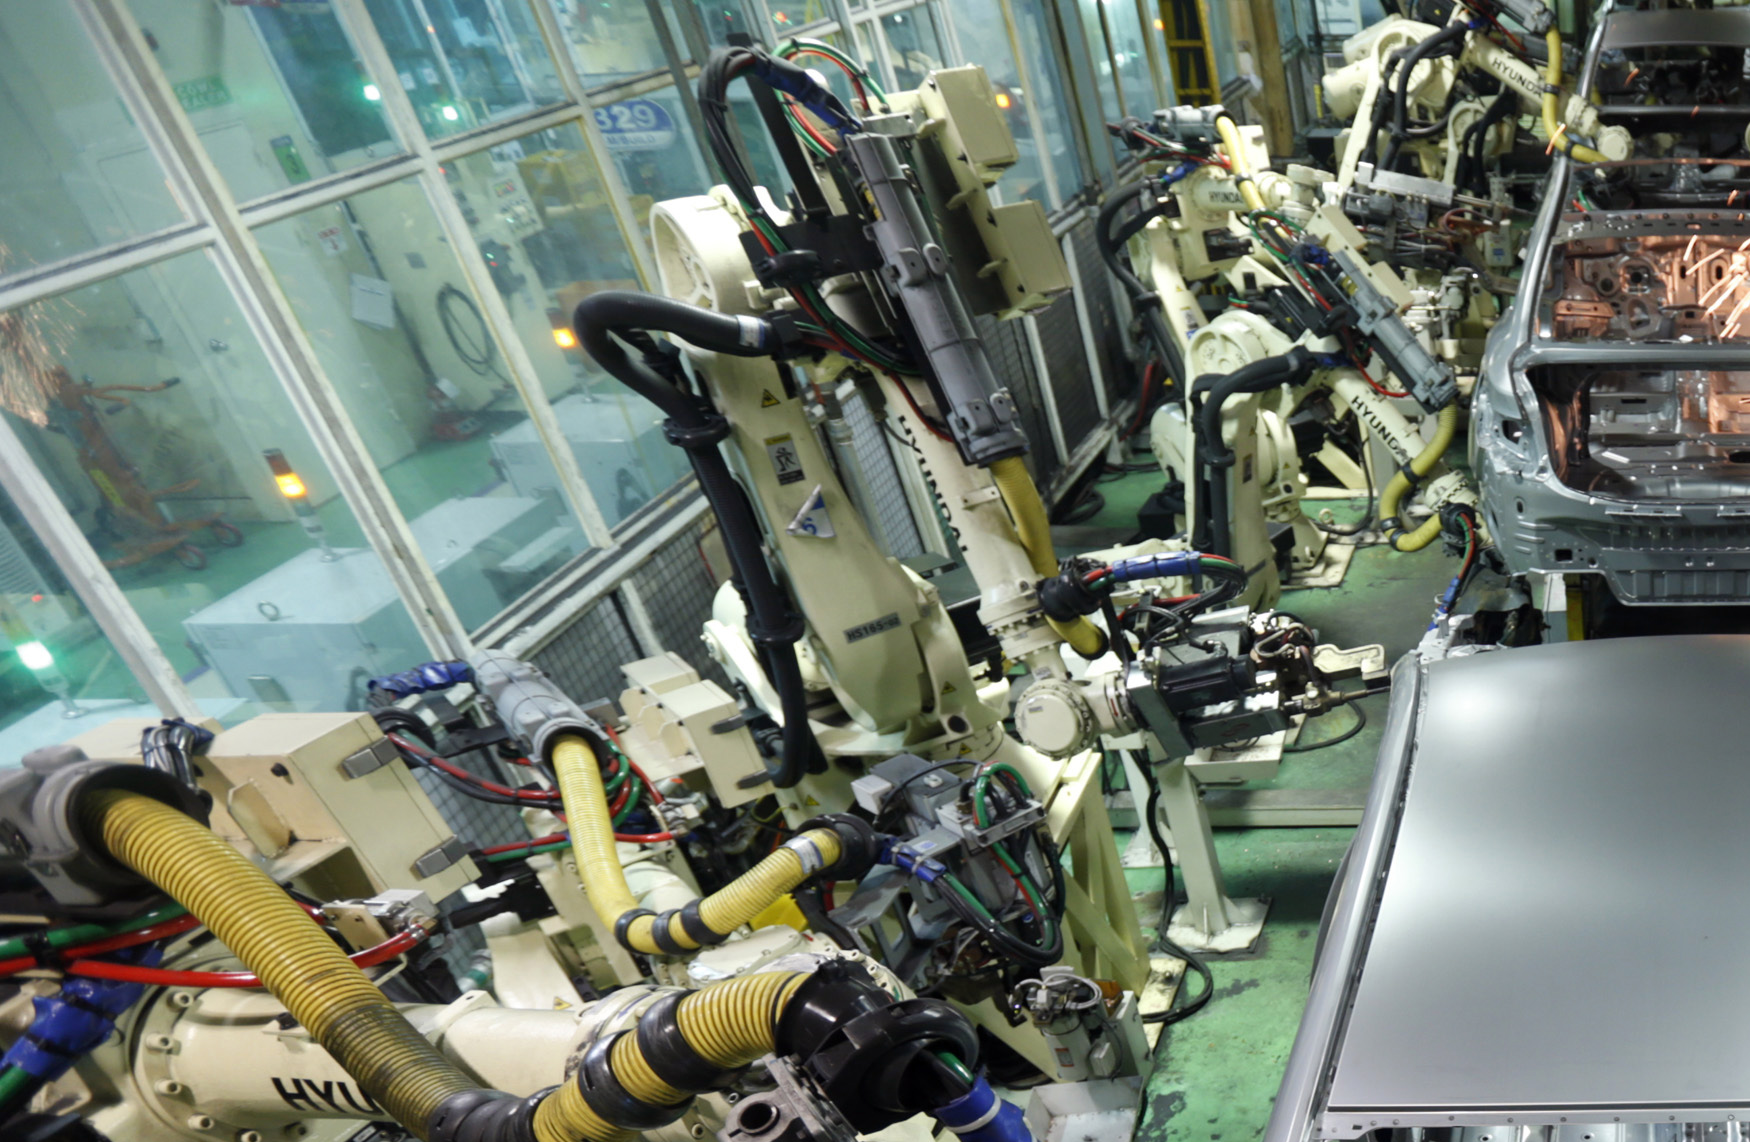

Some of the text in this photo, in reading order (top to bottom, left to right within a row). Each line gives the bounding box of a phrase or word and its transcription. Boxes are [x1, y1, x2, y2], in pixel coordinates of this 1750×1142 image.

[1492, 57, 1542, 98] HYUNDA
[594, 105, 657, 130] 329
[1351, 395, 1411, 462] HYUNDA
[271, 1077, 385, 1115] HYU
